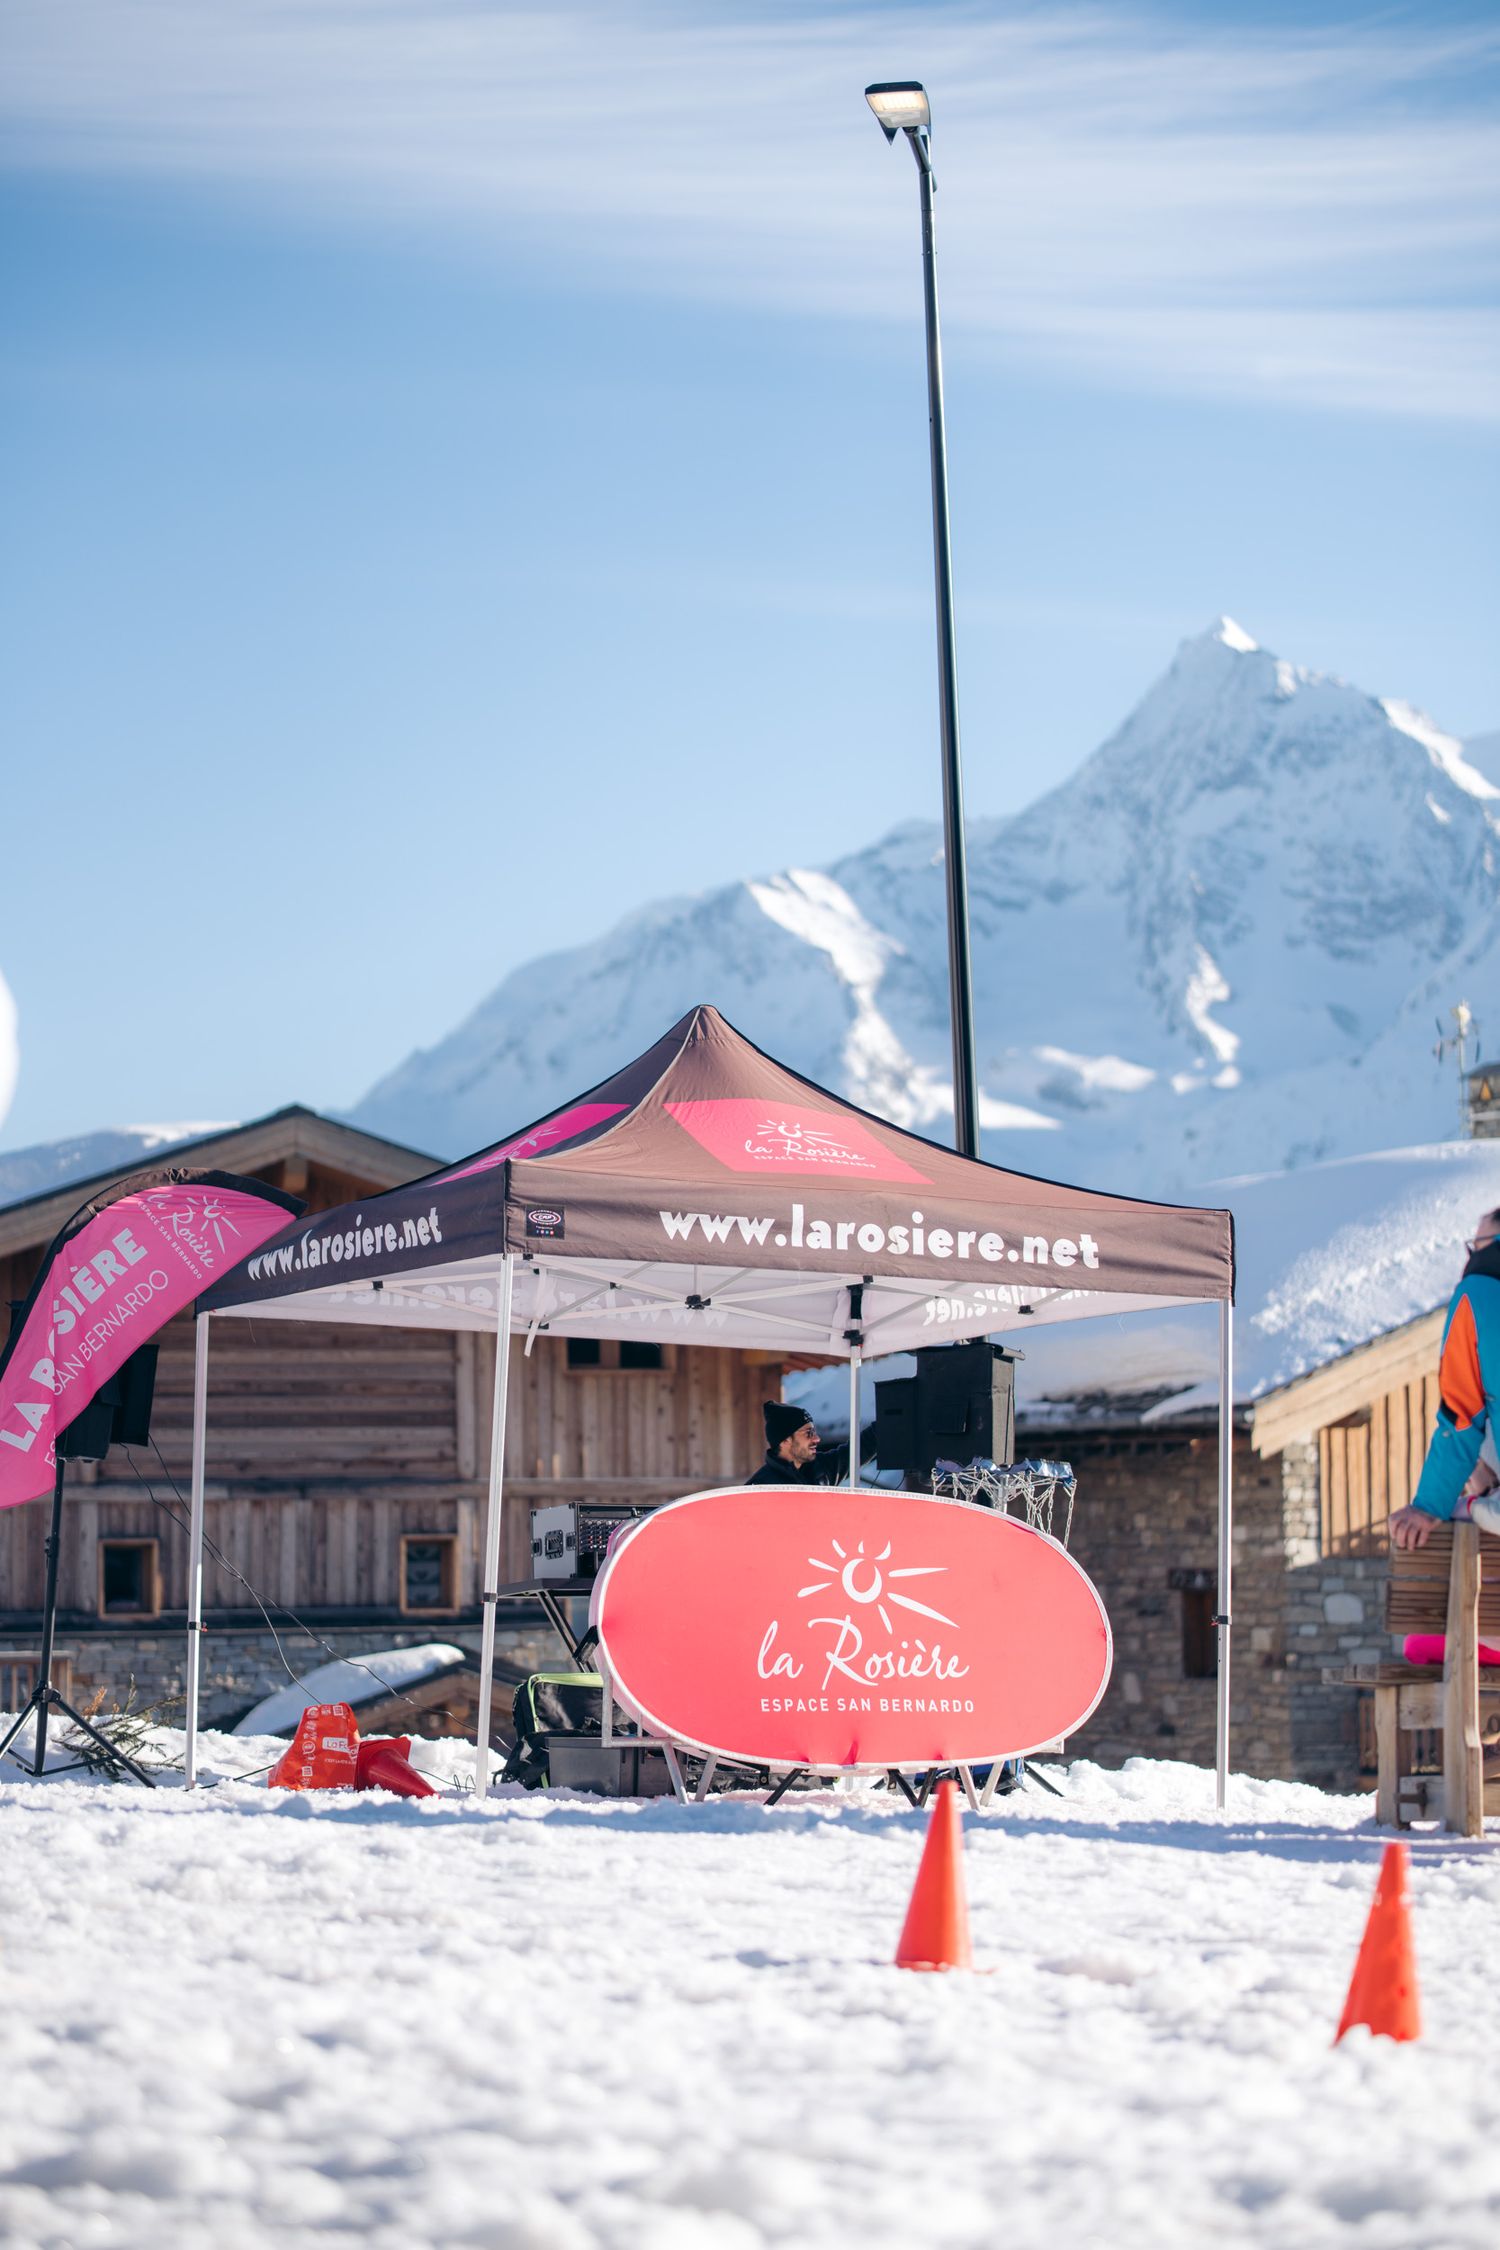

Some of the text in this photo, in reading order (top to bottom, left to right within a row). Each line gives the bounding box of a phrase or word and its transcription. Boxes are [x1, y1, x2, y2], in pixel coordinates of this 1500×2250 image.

[745, 1139, 772, 1153] la
[158, 1226, 173, 1242] SAN
[170, 1241, 203, 1280] BERNARDO
[247, 1206, 442, 1281] www.larosiere.net
[658, 1203, 1100, 1270] www.larosiere.net
[78, 1269, 169, 1362] BERNARDO
[0, 1402, 52, 1453] LA
[757, 1614, 970, 1691] la Rosière
[760, 1698, 975, 1713] ESPACE SAN BERNARDO
